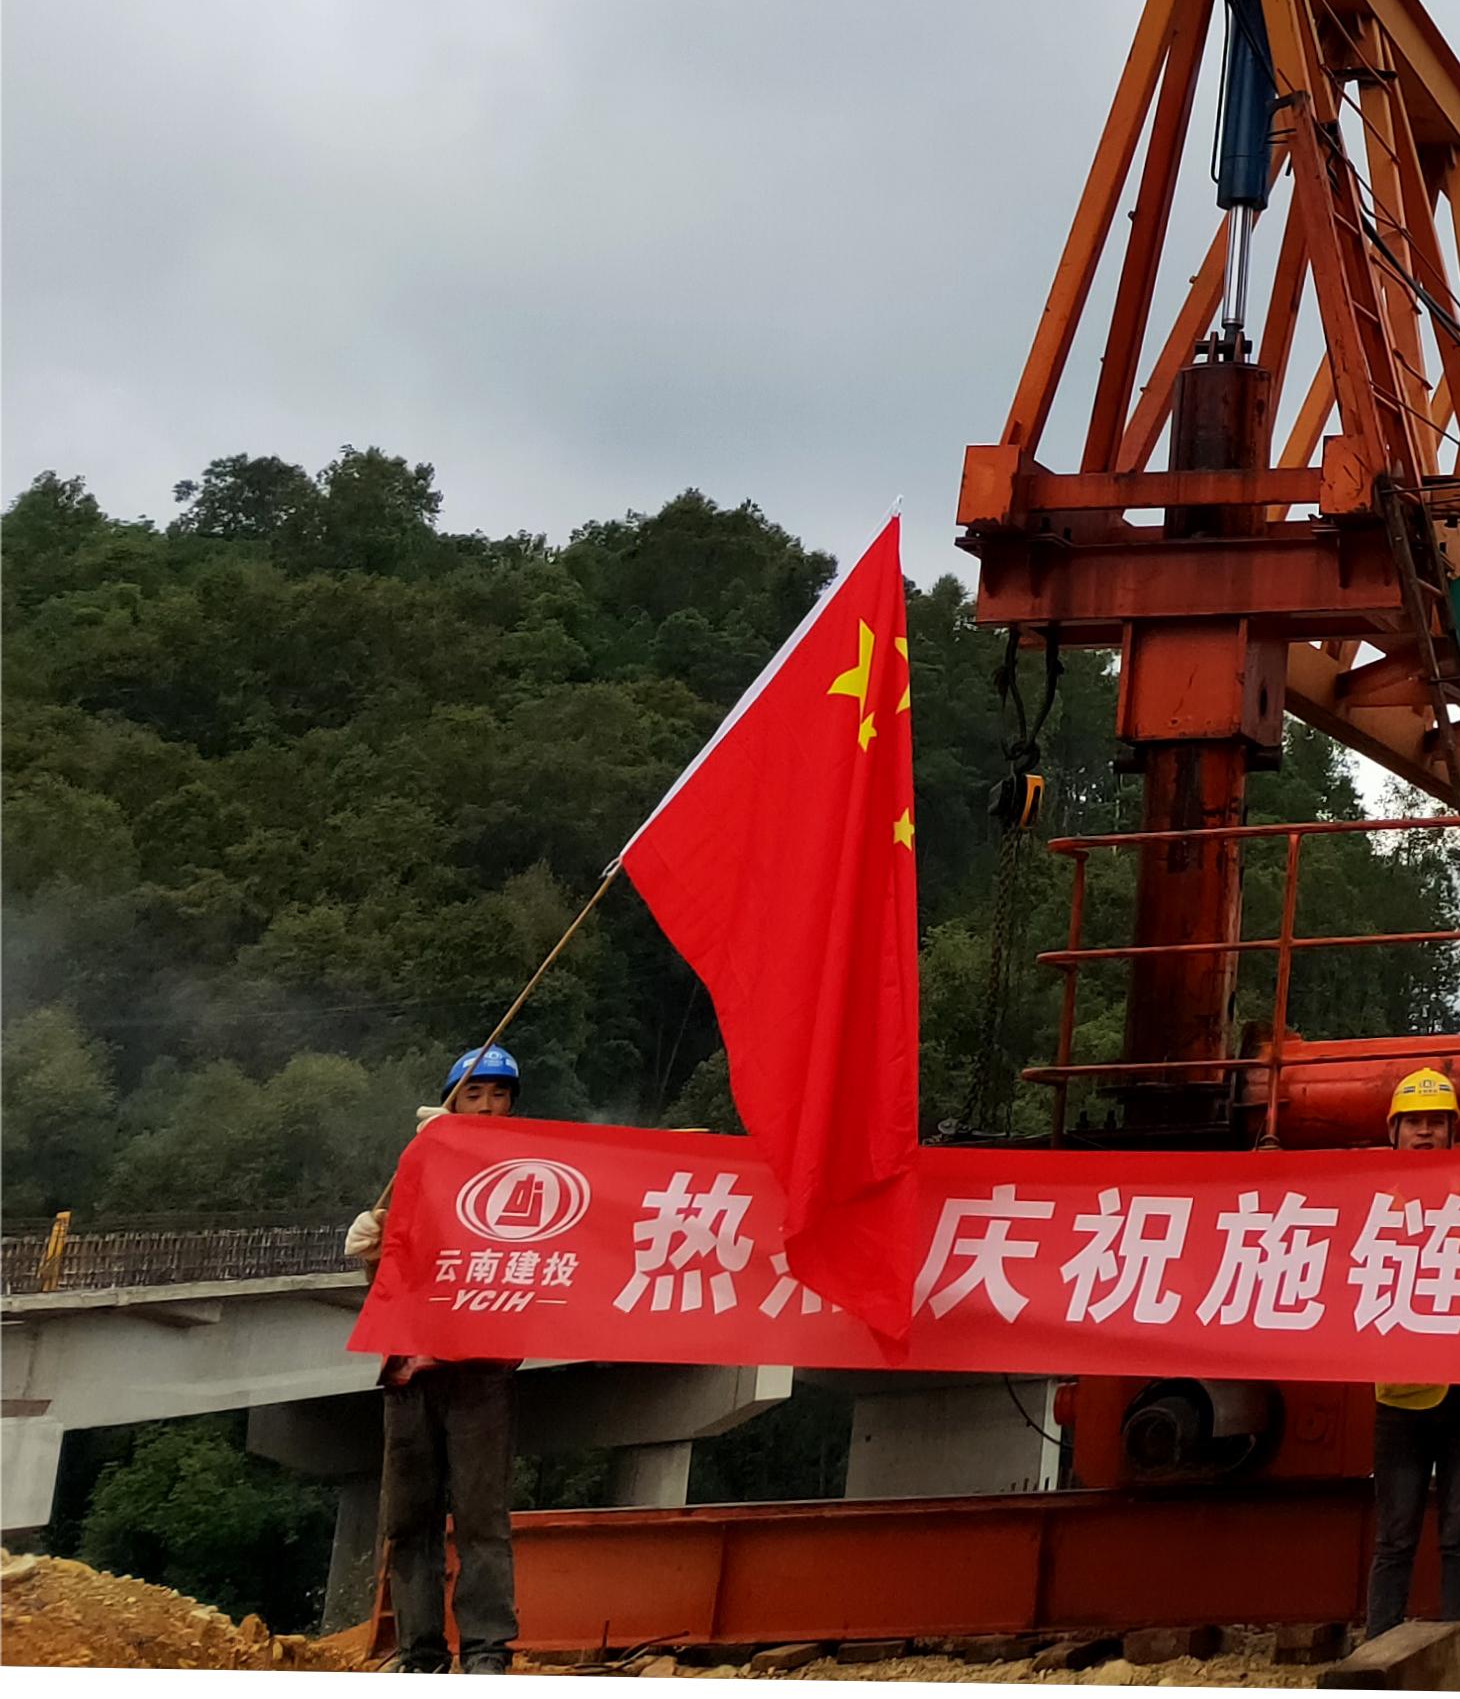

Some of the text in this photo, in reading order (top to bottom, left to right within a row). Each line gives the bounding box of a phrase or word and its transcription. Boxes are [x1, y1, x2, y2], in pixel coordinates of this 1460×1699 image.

[433, 1249, 581, 1288] 云南建投
[450, 1289, 535, 1314] YCIH
